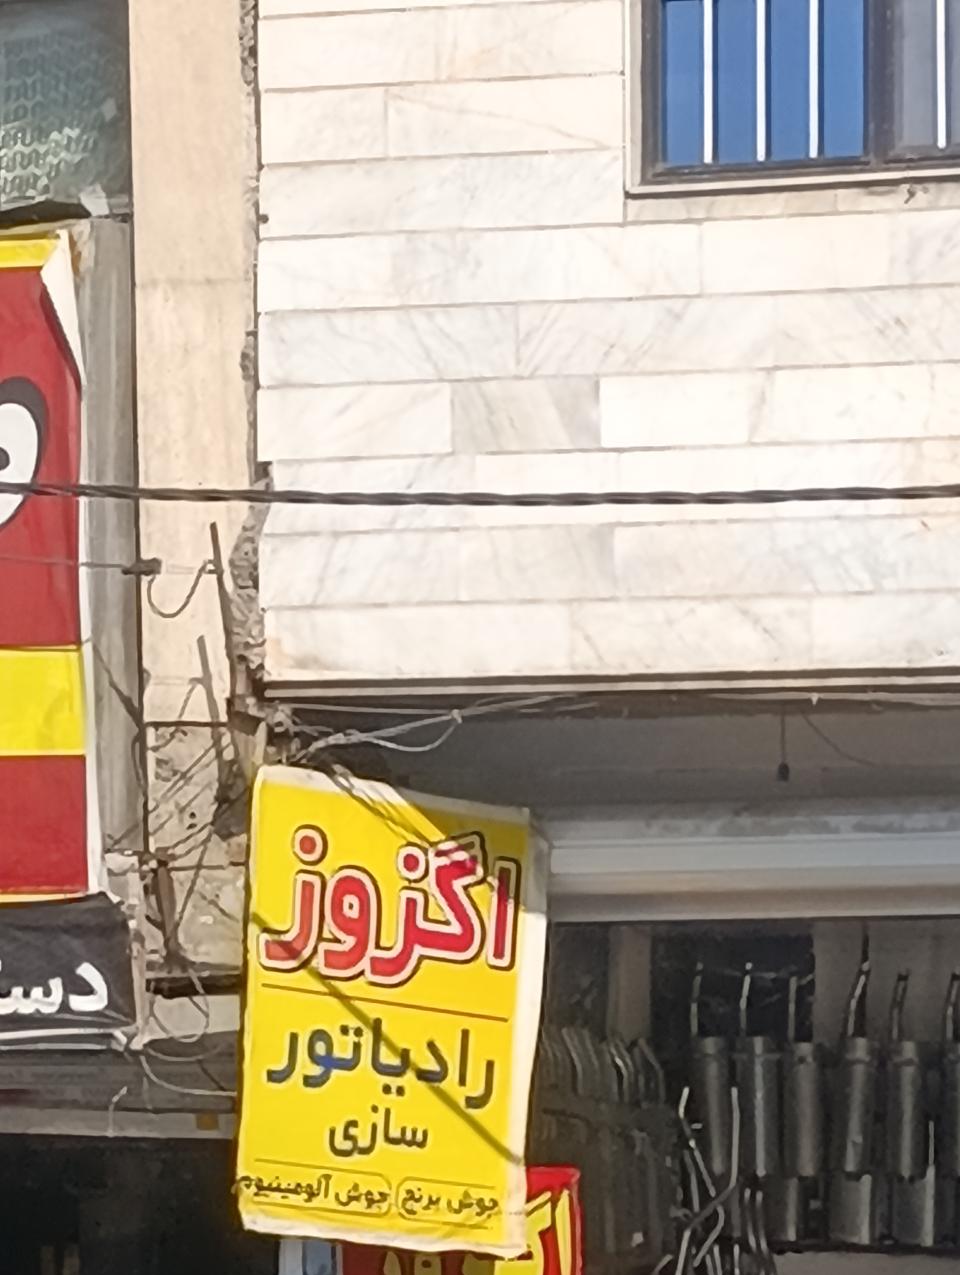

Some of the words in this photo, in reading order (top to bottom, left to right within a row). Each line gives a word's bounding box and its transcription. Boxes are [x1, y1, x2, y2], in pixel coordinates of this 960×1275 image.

[258, 825, 520, 987] اگزوز
[0, 961, 108, 1015] دس
[266, 1017, 495, 1109] رادیاتور
[328, 1105, 429, 1157] سازی
[334, 1182, 391, 1209] جوش
[401, 1186, 441, 1216] برنج
[447, 1189, 499, 1218] جوش
